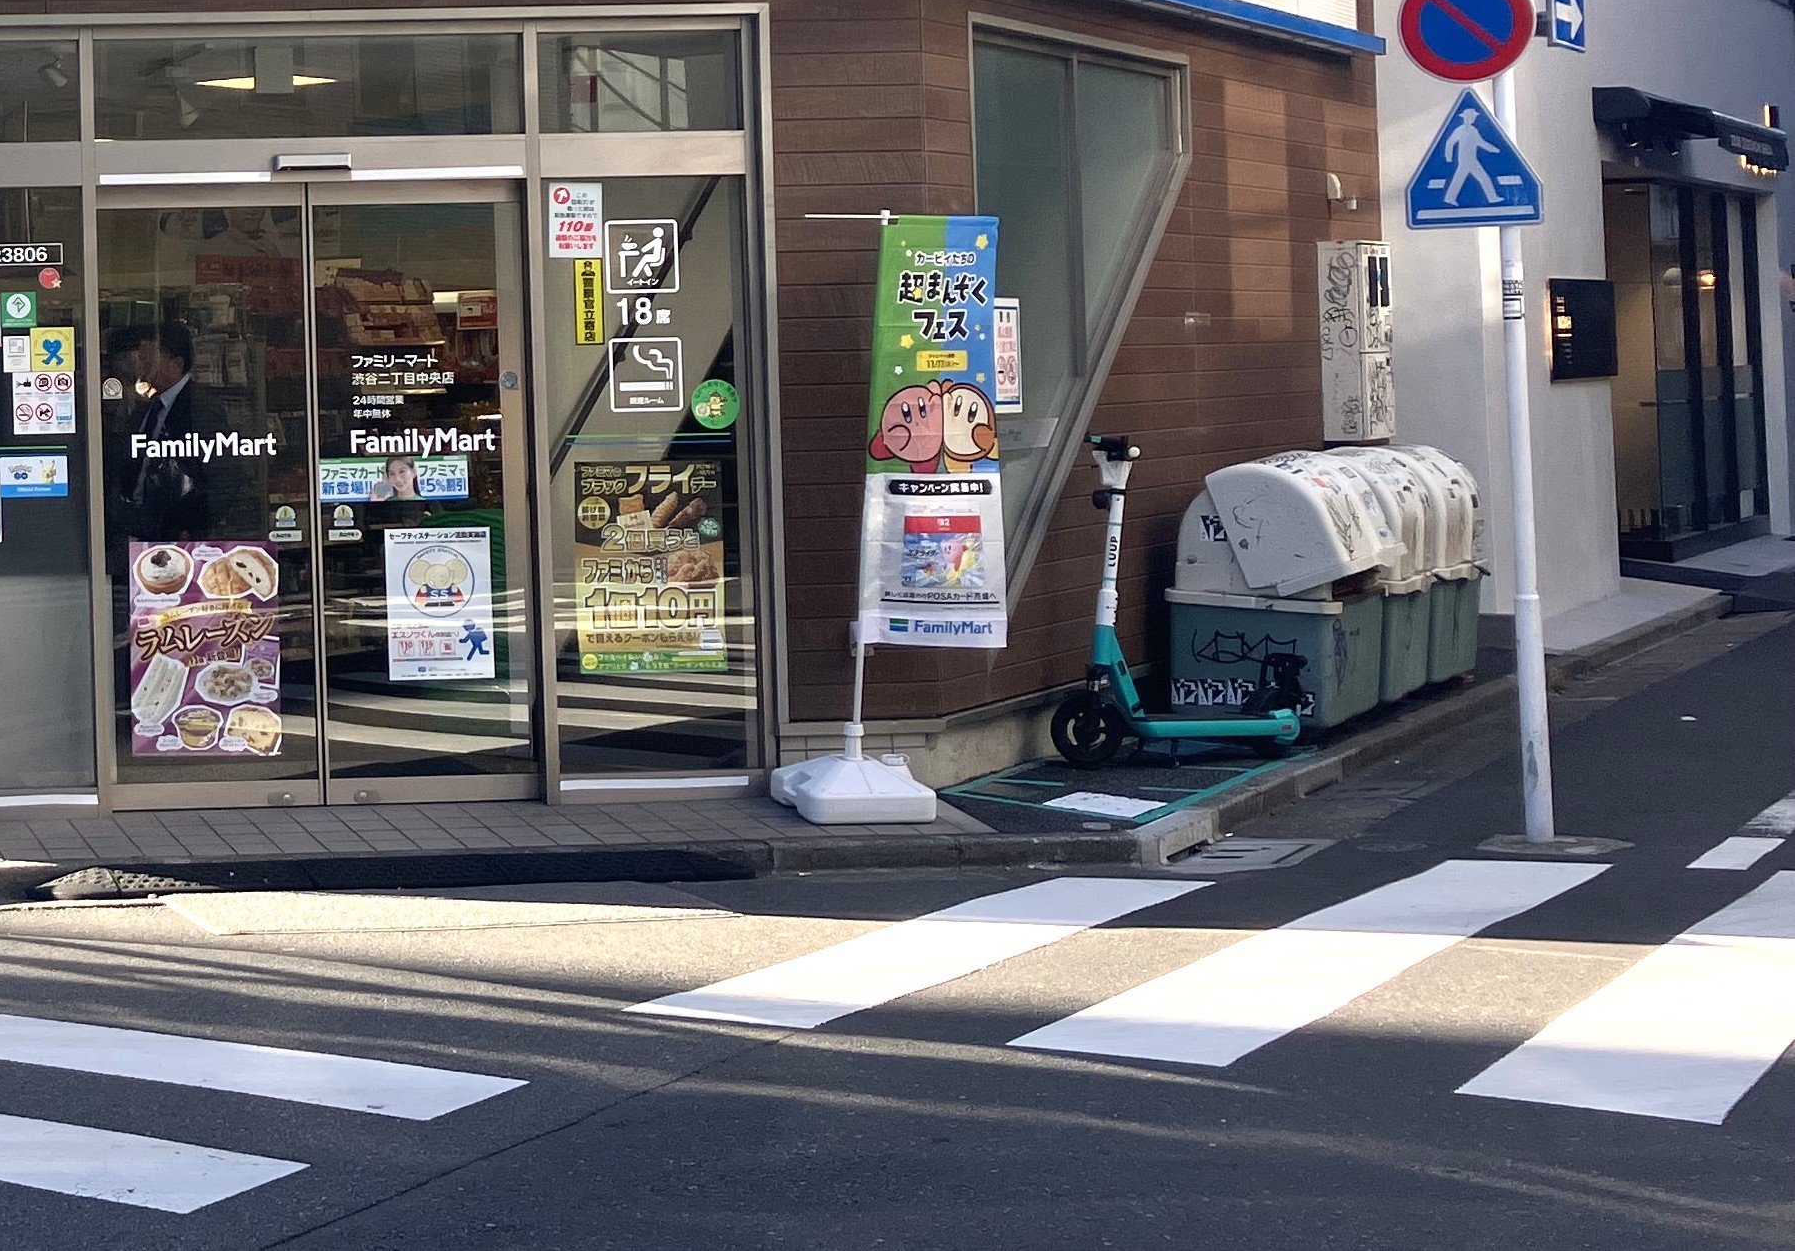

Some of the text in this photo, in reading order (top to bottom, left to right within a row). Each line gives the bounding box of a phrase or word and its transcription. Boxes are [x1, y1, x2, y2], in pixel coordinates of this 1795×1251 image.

[627, 278, 659, 286] イートイン
[898, 271, 989, 305] 超まんぞく
[912, 309, 969, 341] フェス
[351, 354, 439, 368] ファミリーマート
[351, 371, 455, 386] 渋谷二丁目中央店
[352, 395, 405, 405] 24時間営業
[130, 432, 277, 463] FamilyMart
[350, 427, 496, 458] FamilyMart
[321, 467, 385, 480] ファミマカード
[1108, 535, 1118, 568] LUUP
[914, 620, 993, 635] FamilyMart
